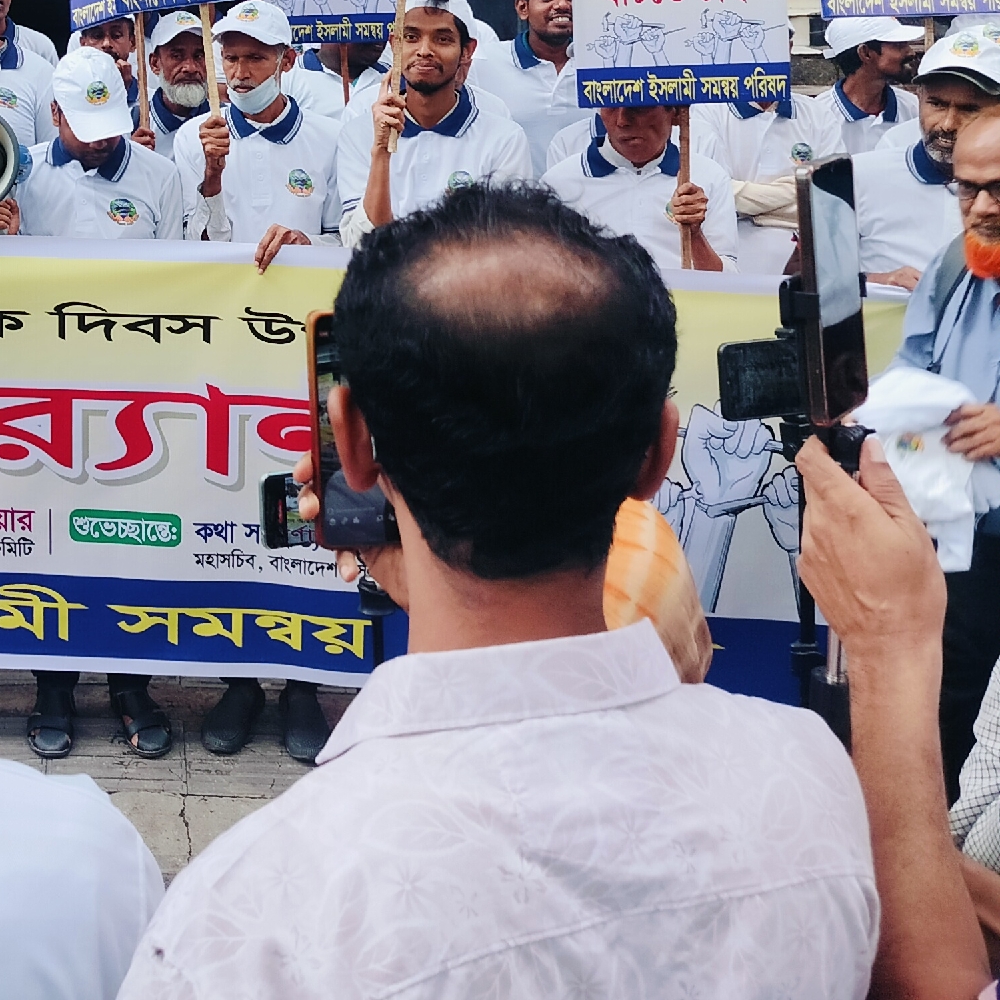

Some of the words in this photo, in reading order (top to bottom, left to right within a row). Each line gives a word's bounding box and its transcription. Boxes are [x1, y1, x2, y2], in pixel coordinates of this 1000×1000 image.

[40, 301, 222, 344] দিবস
[193, 520, 238, 544] কথা
[268, 555, 338, 578] বাংলাদেশ
[106, 603, 373, 660] সমন্বয়
